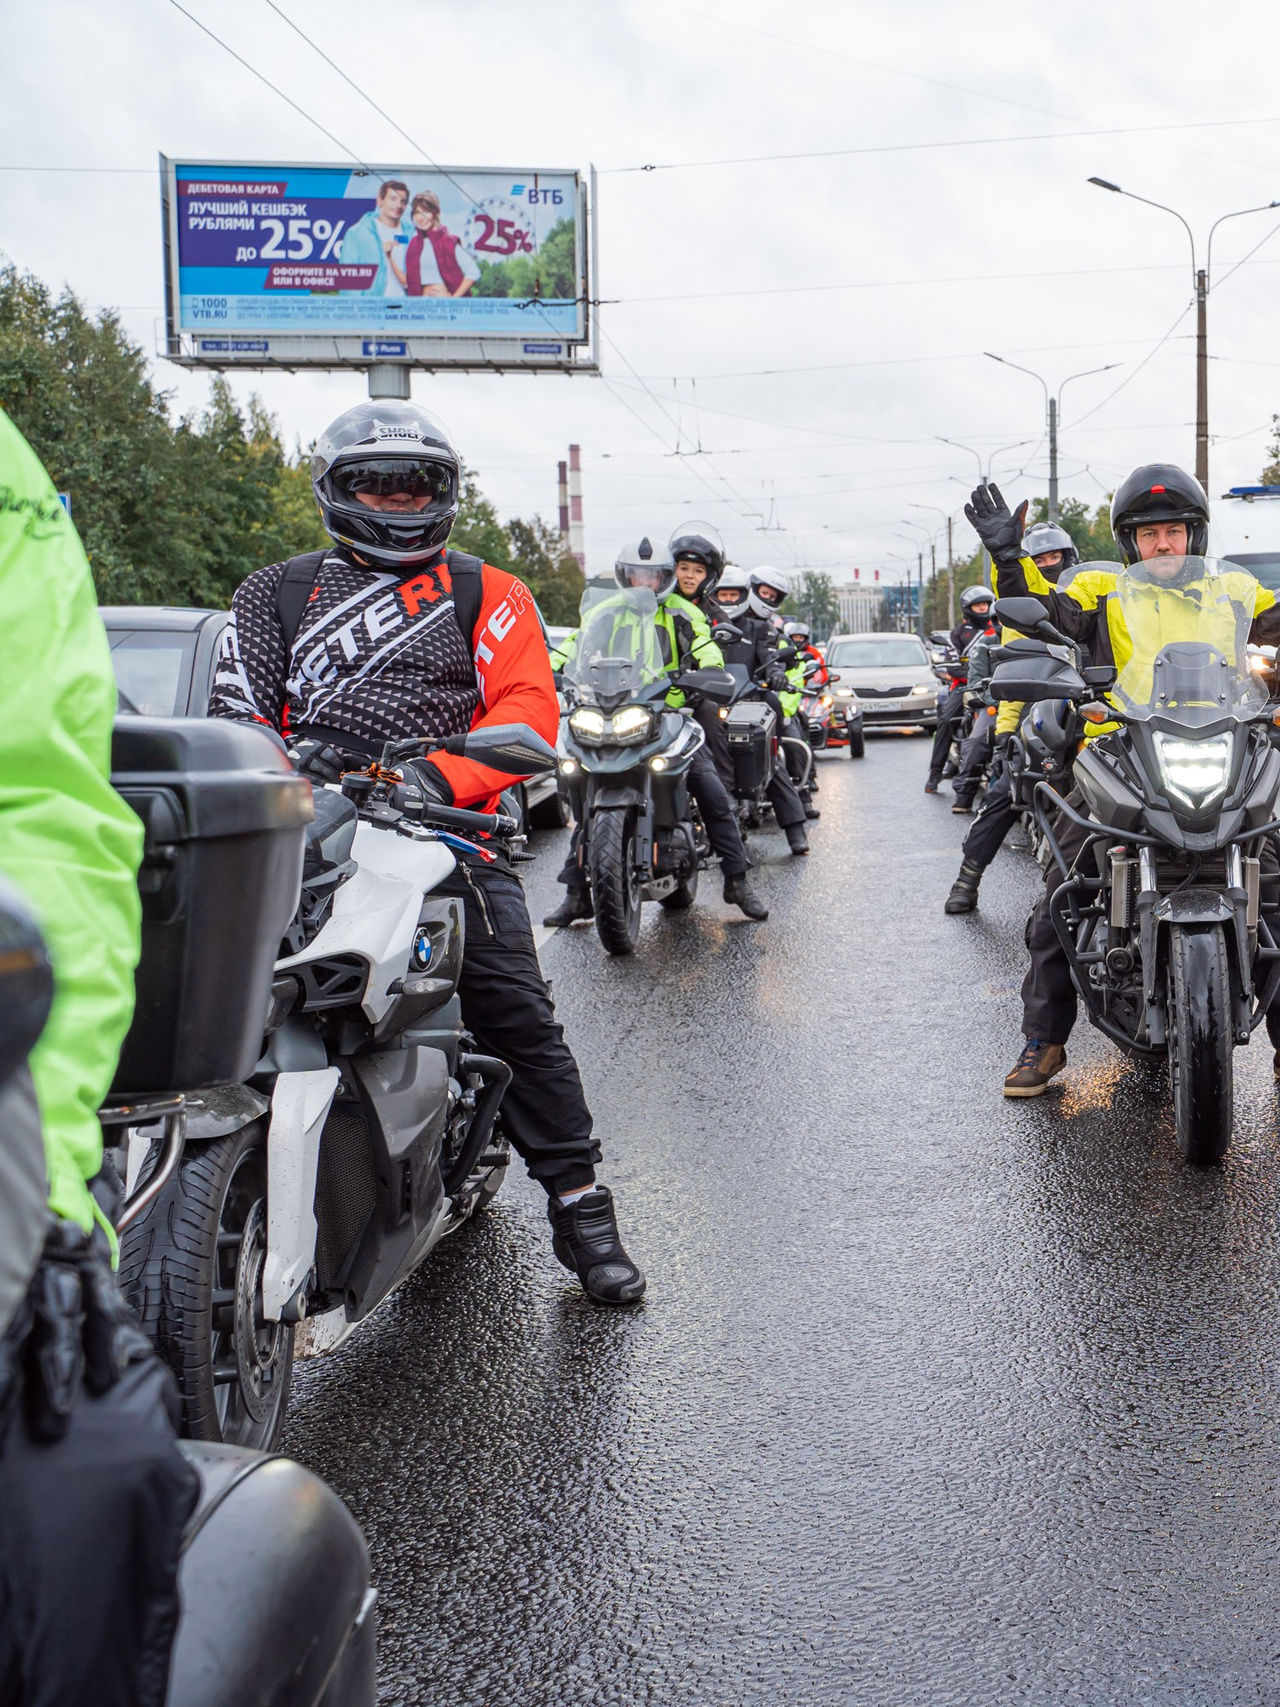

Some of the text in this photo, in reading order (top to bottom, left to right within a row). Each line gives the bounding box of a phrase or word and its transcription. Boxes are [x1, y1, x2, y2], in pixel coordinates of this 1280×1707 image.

[187, 183, 279, 194] ДЕБЕТОВАЯ КАРТА
[528, 189, 563, 205] ВТБ
[188, 199, 307, 217] ЛУЧШИЙ КЕШБЭК
[188, 217, 255, 231] РУБЛЯМИ
[259, 218, 346, 260] 25%
[474, 213, 533, 256] 25%
[272, 266, 373, 277] ОФОРМИТЕ НА VTB.RU
[273, 277, 335, 286] ИЛИ В ОФИСЕ
[201, 298, 228, 309] 1000
[192, 309, 228, 319] VTB.RU
[378, 427, 419, 440] SHOEI
